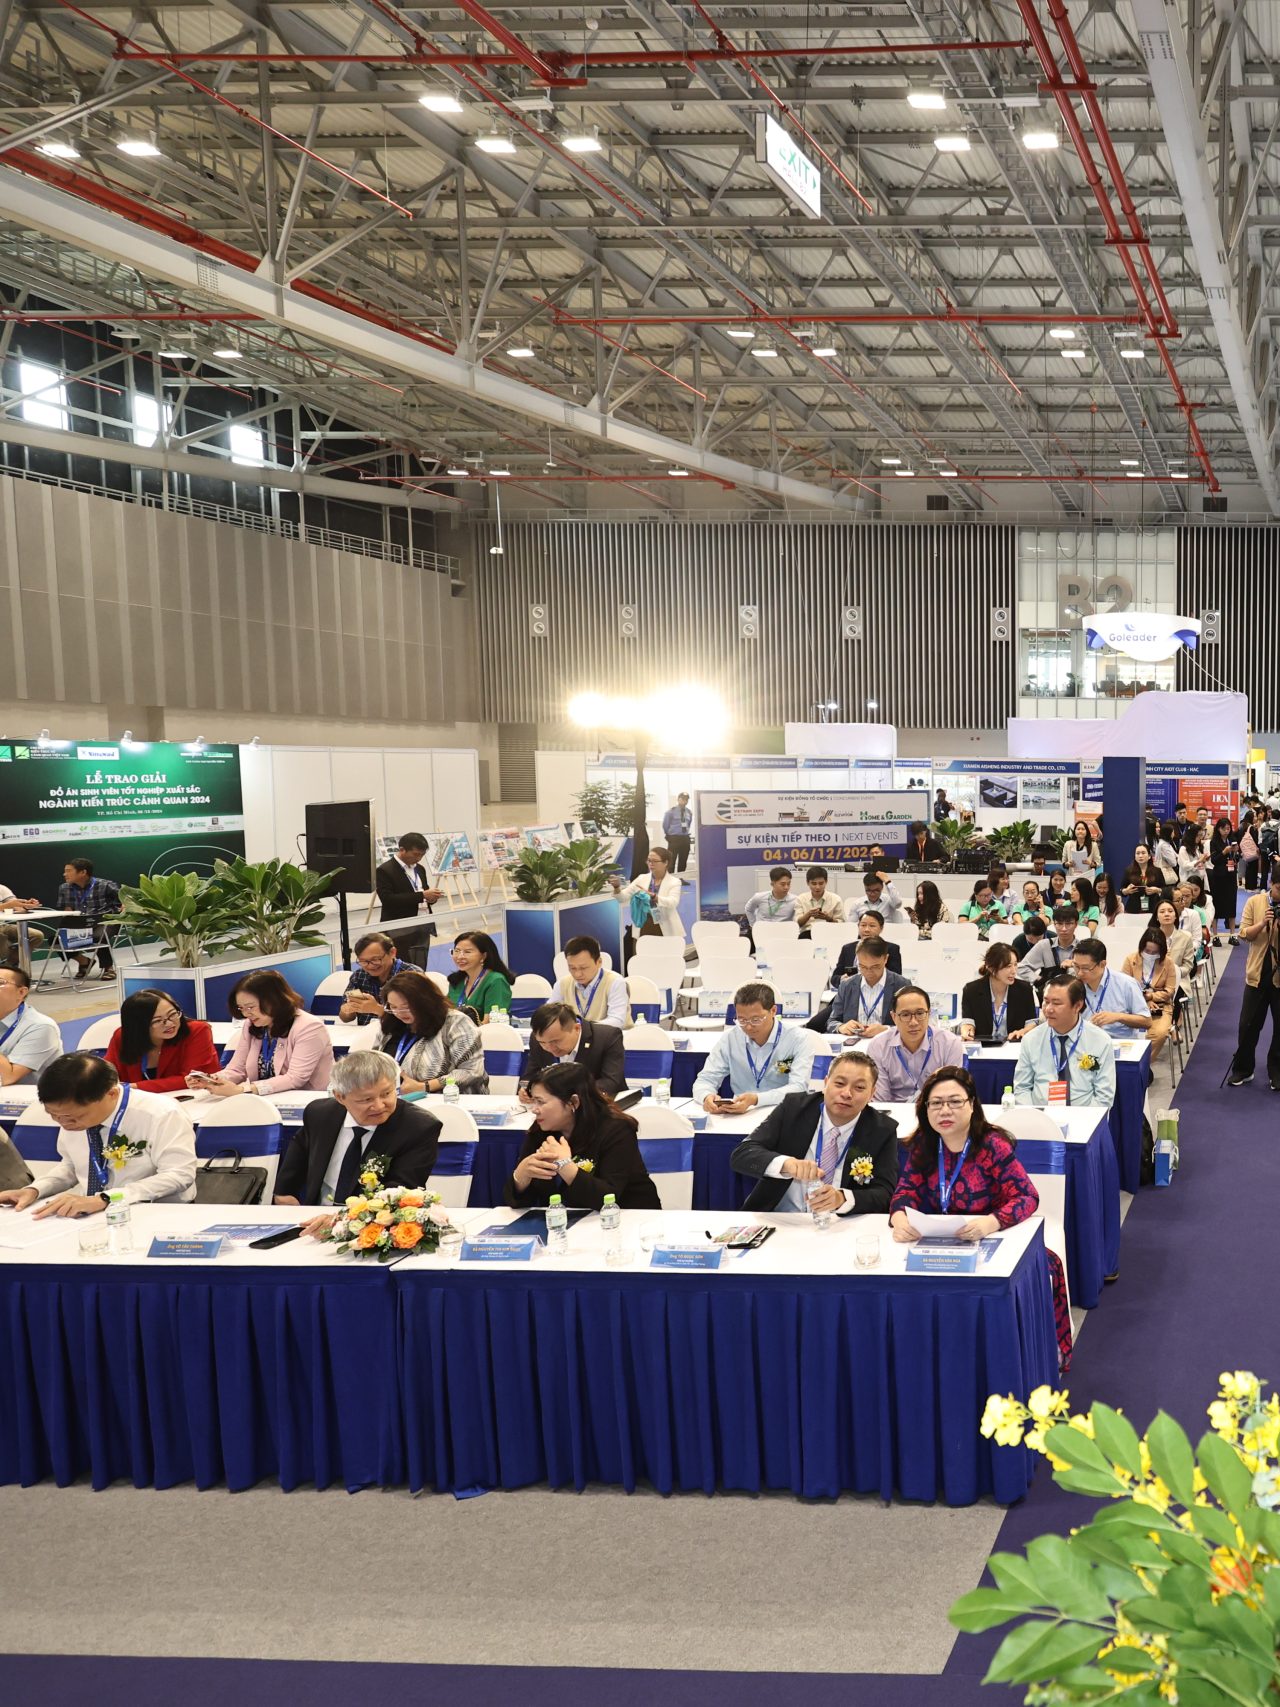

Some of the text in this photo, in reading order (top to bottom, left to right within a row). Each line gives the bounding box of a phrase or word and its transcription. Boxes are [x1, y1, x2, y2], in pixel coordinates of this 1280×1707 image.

[1109, 632, 1158, 642] Goleader
[86, 770, 167, 783] LỄ TRAO GIẢI
[50, 784, 201, 797] ĐỒ ÁN SINH VIÊN TỐT NGHIỆP XUẤT SẮC
[39, 795, 210, 809] NGÀNH KIẾN TRÚC CẢNH QUAN 2024
[859, 811, 880, 821] HOME
[885, 810, 912, 820] GARDEN
[737, 831, 899, 846] SỰ KIỆN TIẾP THEO NEXT EVENTS
[763, 850, 782, 861] 04
